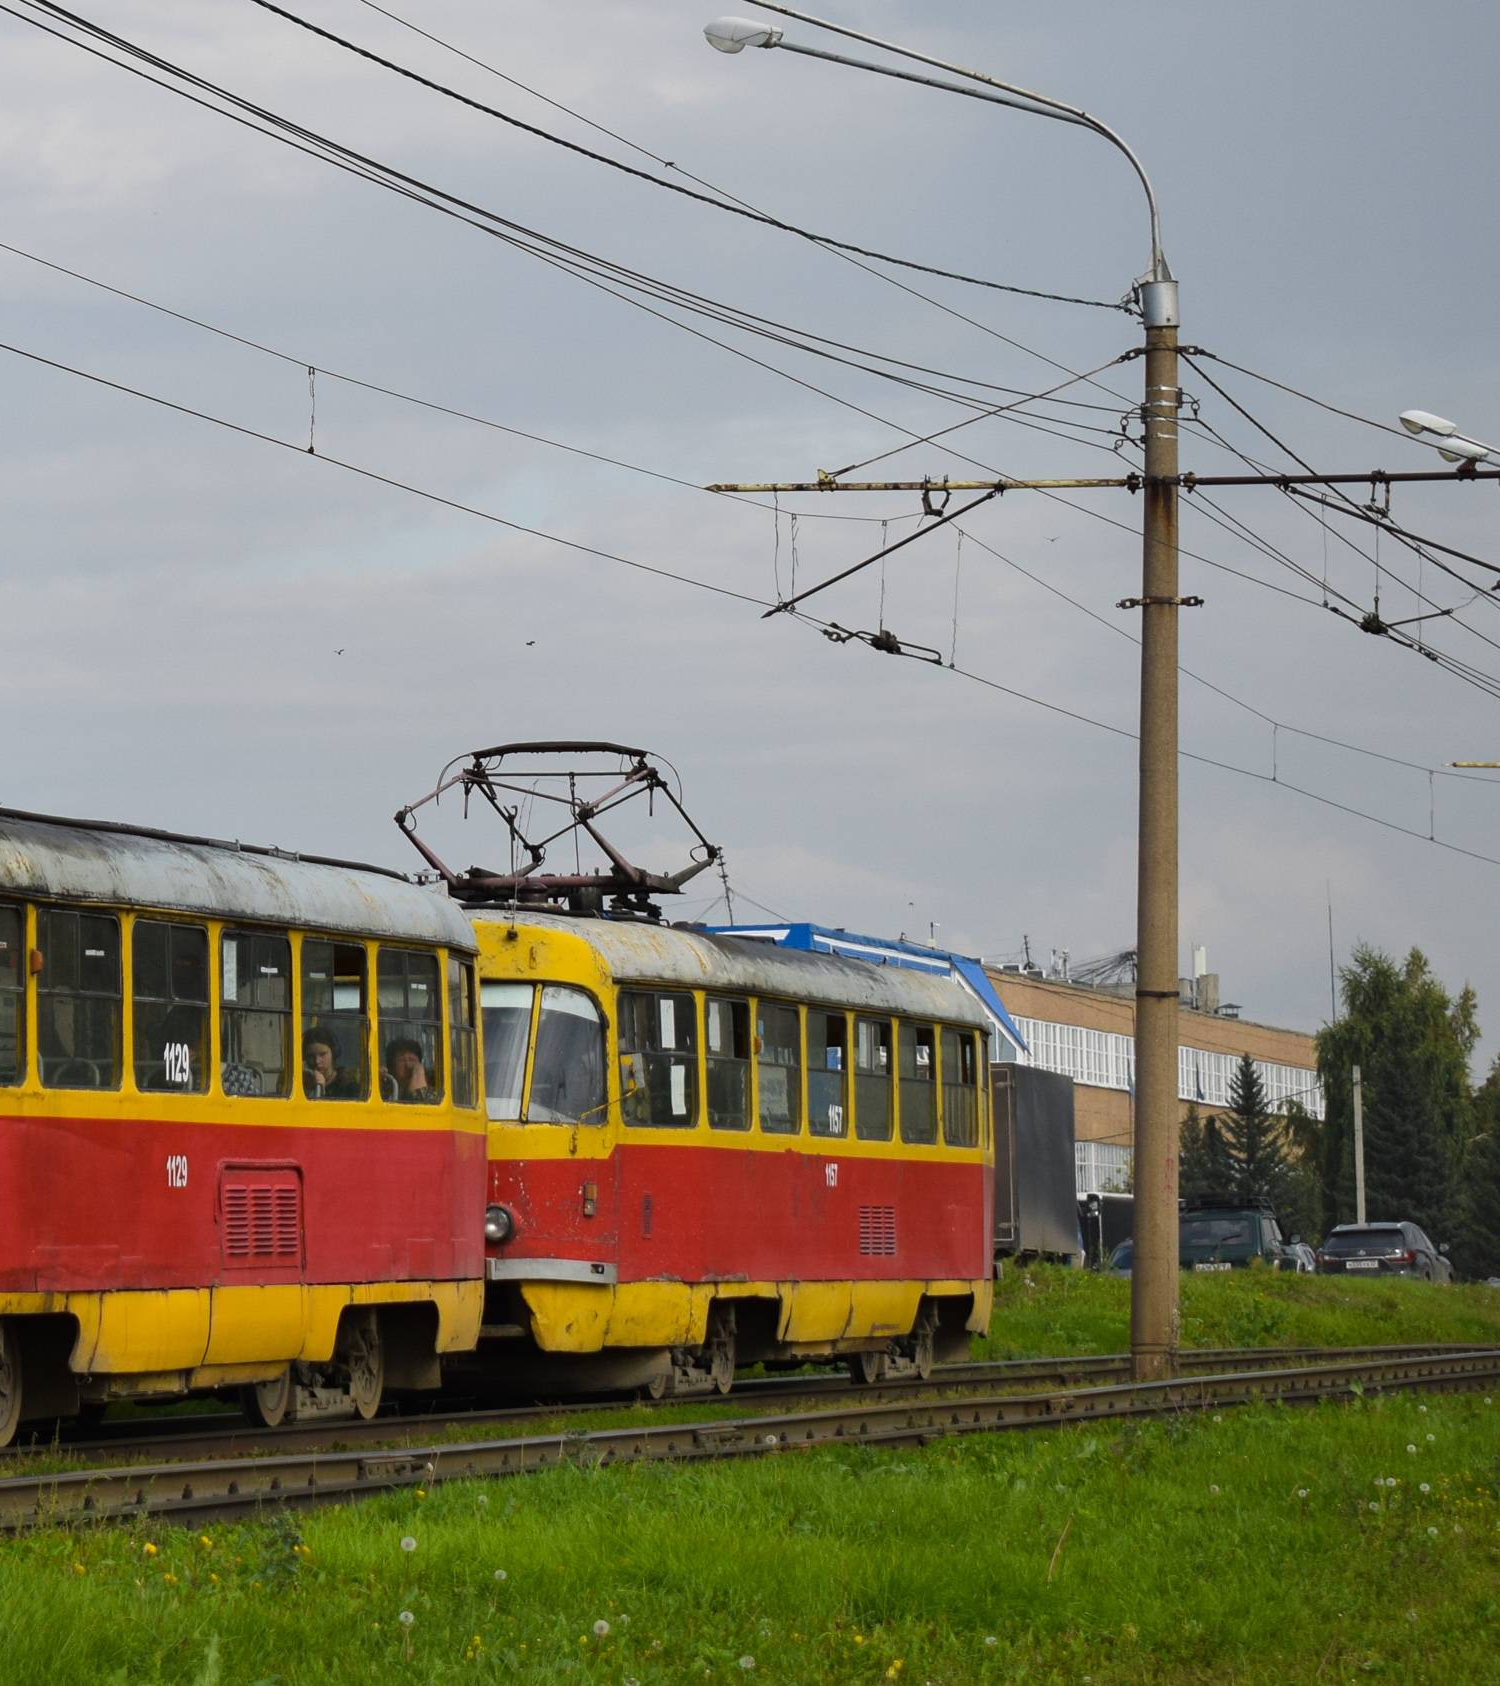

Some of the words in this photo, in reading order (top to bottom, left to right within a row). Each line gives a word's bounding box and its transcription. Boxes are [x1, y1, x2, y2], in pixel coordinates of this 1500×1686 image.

[163, 1042, 190, 1082] 1129
[828, 1103, 843, 1134] 1157
[166, 1154, 188, 1188] 1129
[825, 1162, 838, 1188] 1157
